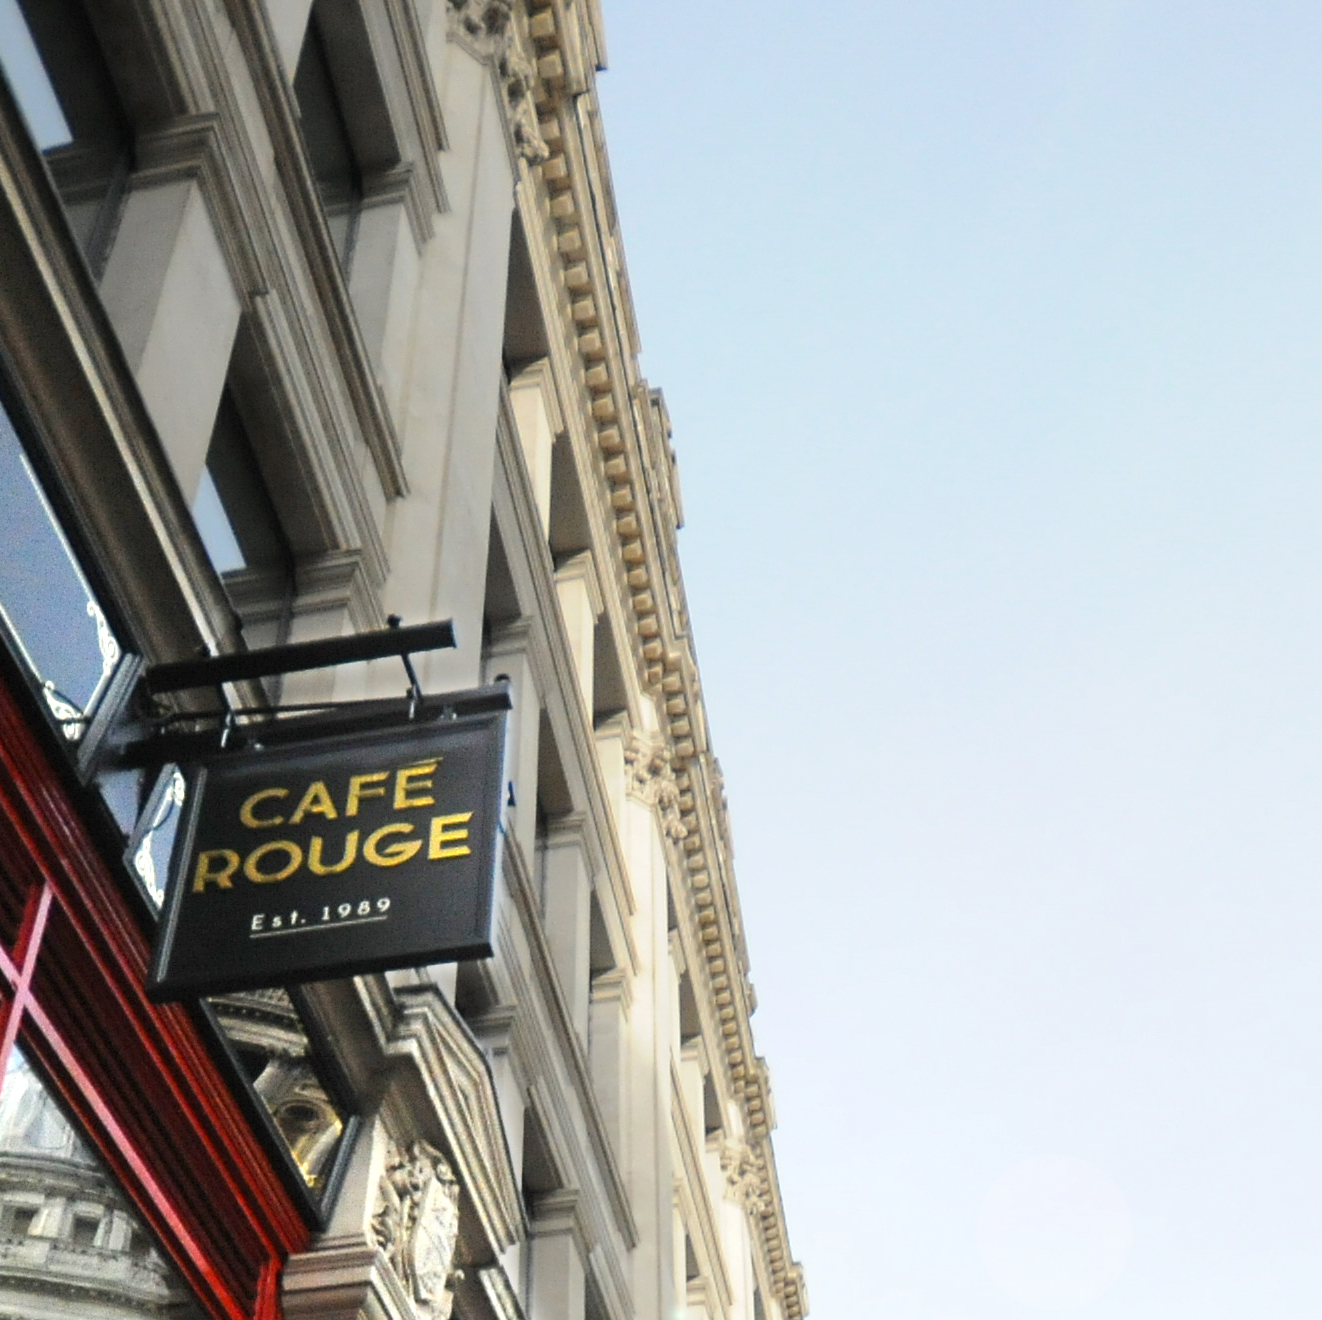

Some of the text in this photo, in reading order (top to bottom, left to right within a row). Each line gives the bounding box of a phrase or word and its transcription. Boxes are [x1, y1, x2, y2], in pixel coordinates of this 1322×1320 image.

[192, 811, 474, 893] ROUGE
[250, 898, 392, 931] Est. 1989
